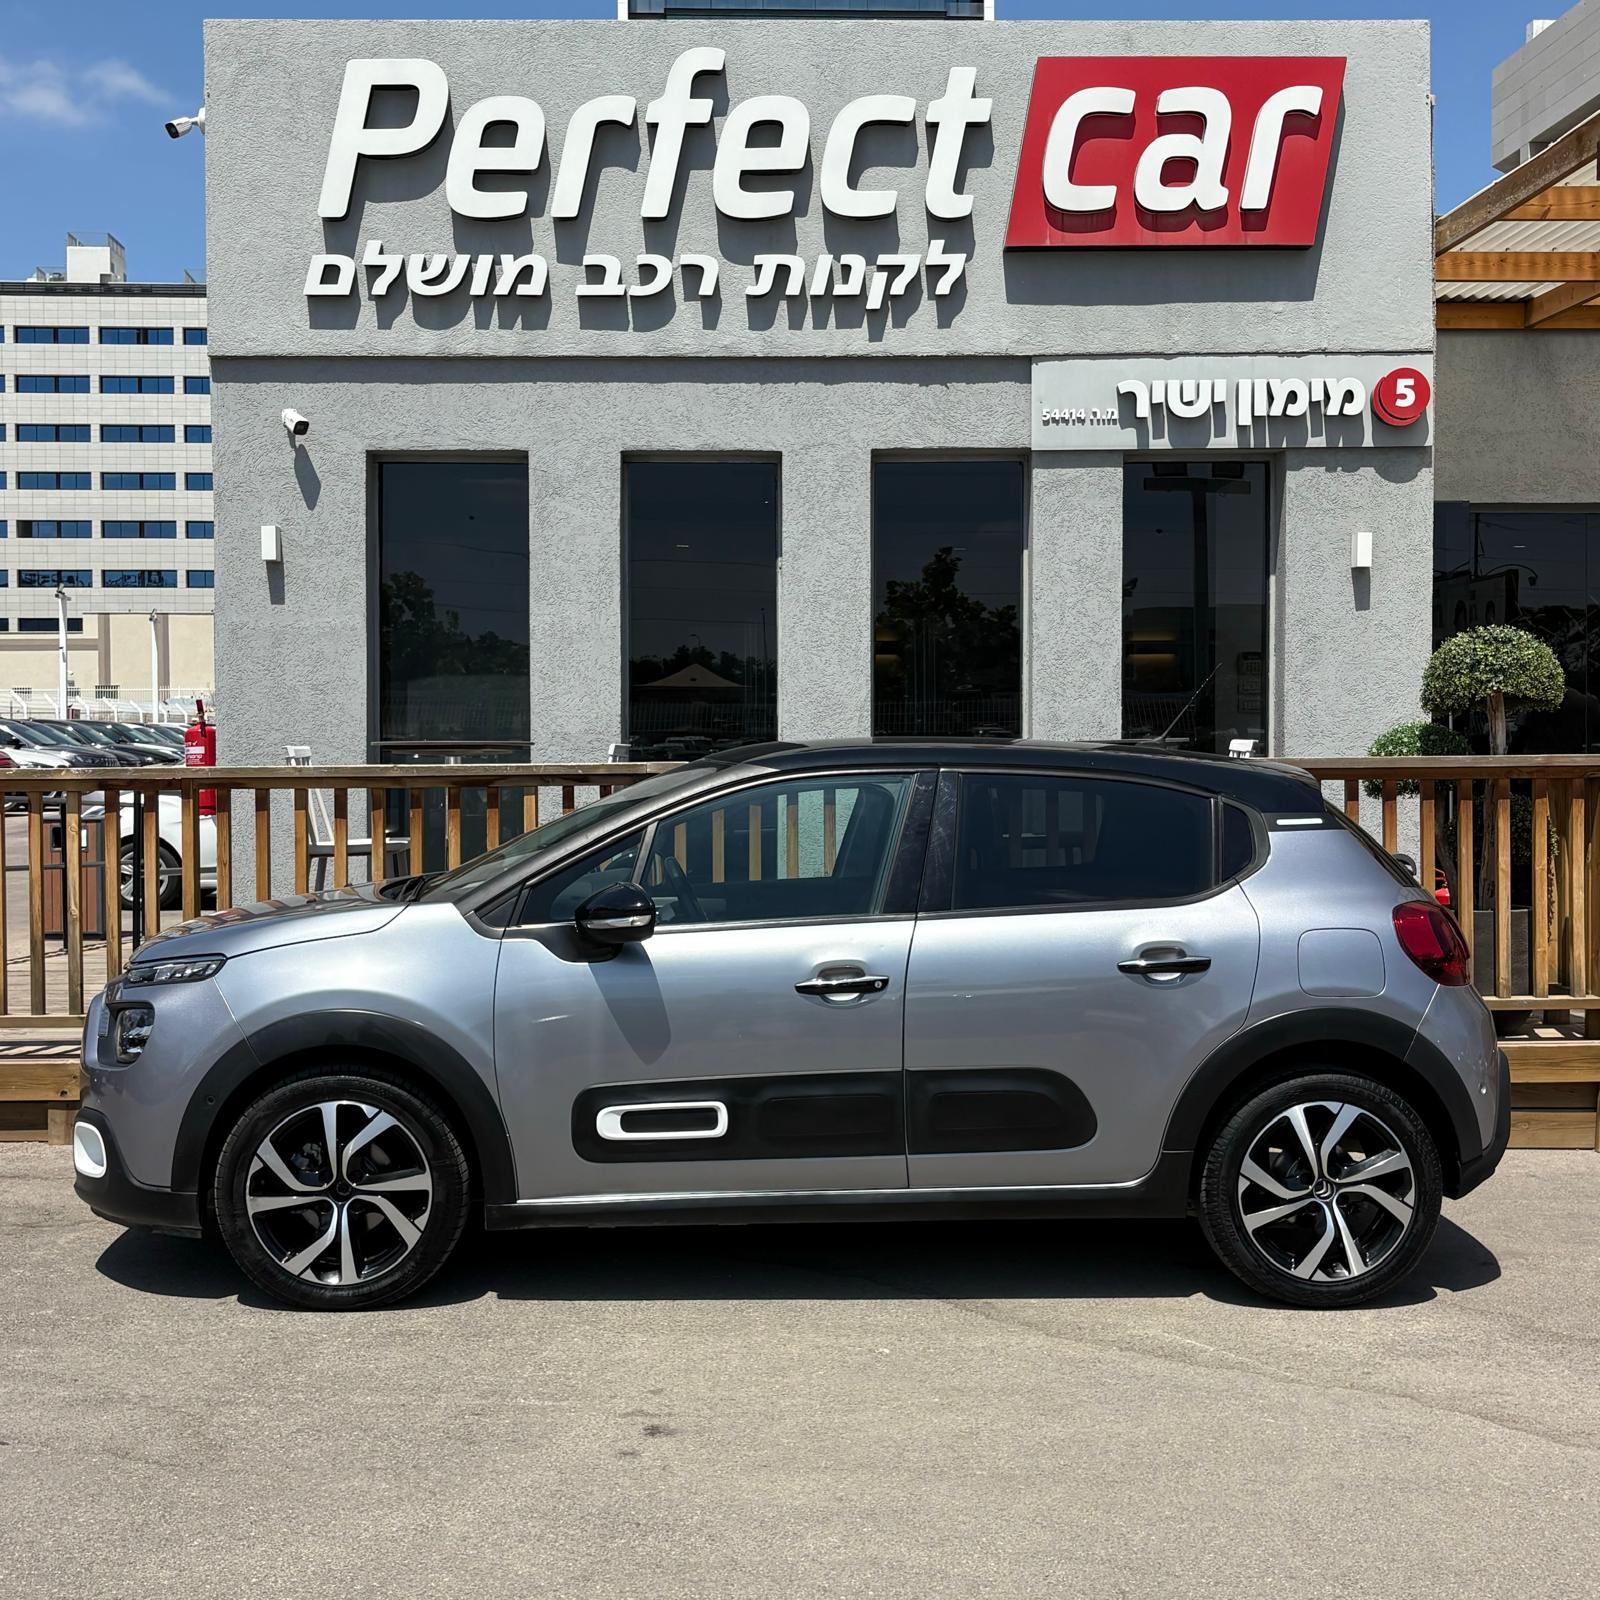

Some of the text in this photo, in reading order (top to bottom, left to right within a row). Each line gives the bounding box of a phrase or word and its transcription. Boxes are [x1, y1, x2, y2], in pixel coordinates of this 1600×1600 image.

[317, 46, 1324, 219] Perfect car
[302, 239, 967, 310] לקנות רכב מושלם
[1041, 408, 1087, 421] 54414
[1116, 377, 1367, 427] מימון ישיר
[1394, 377, 1417, 408] 5
